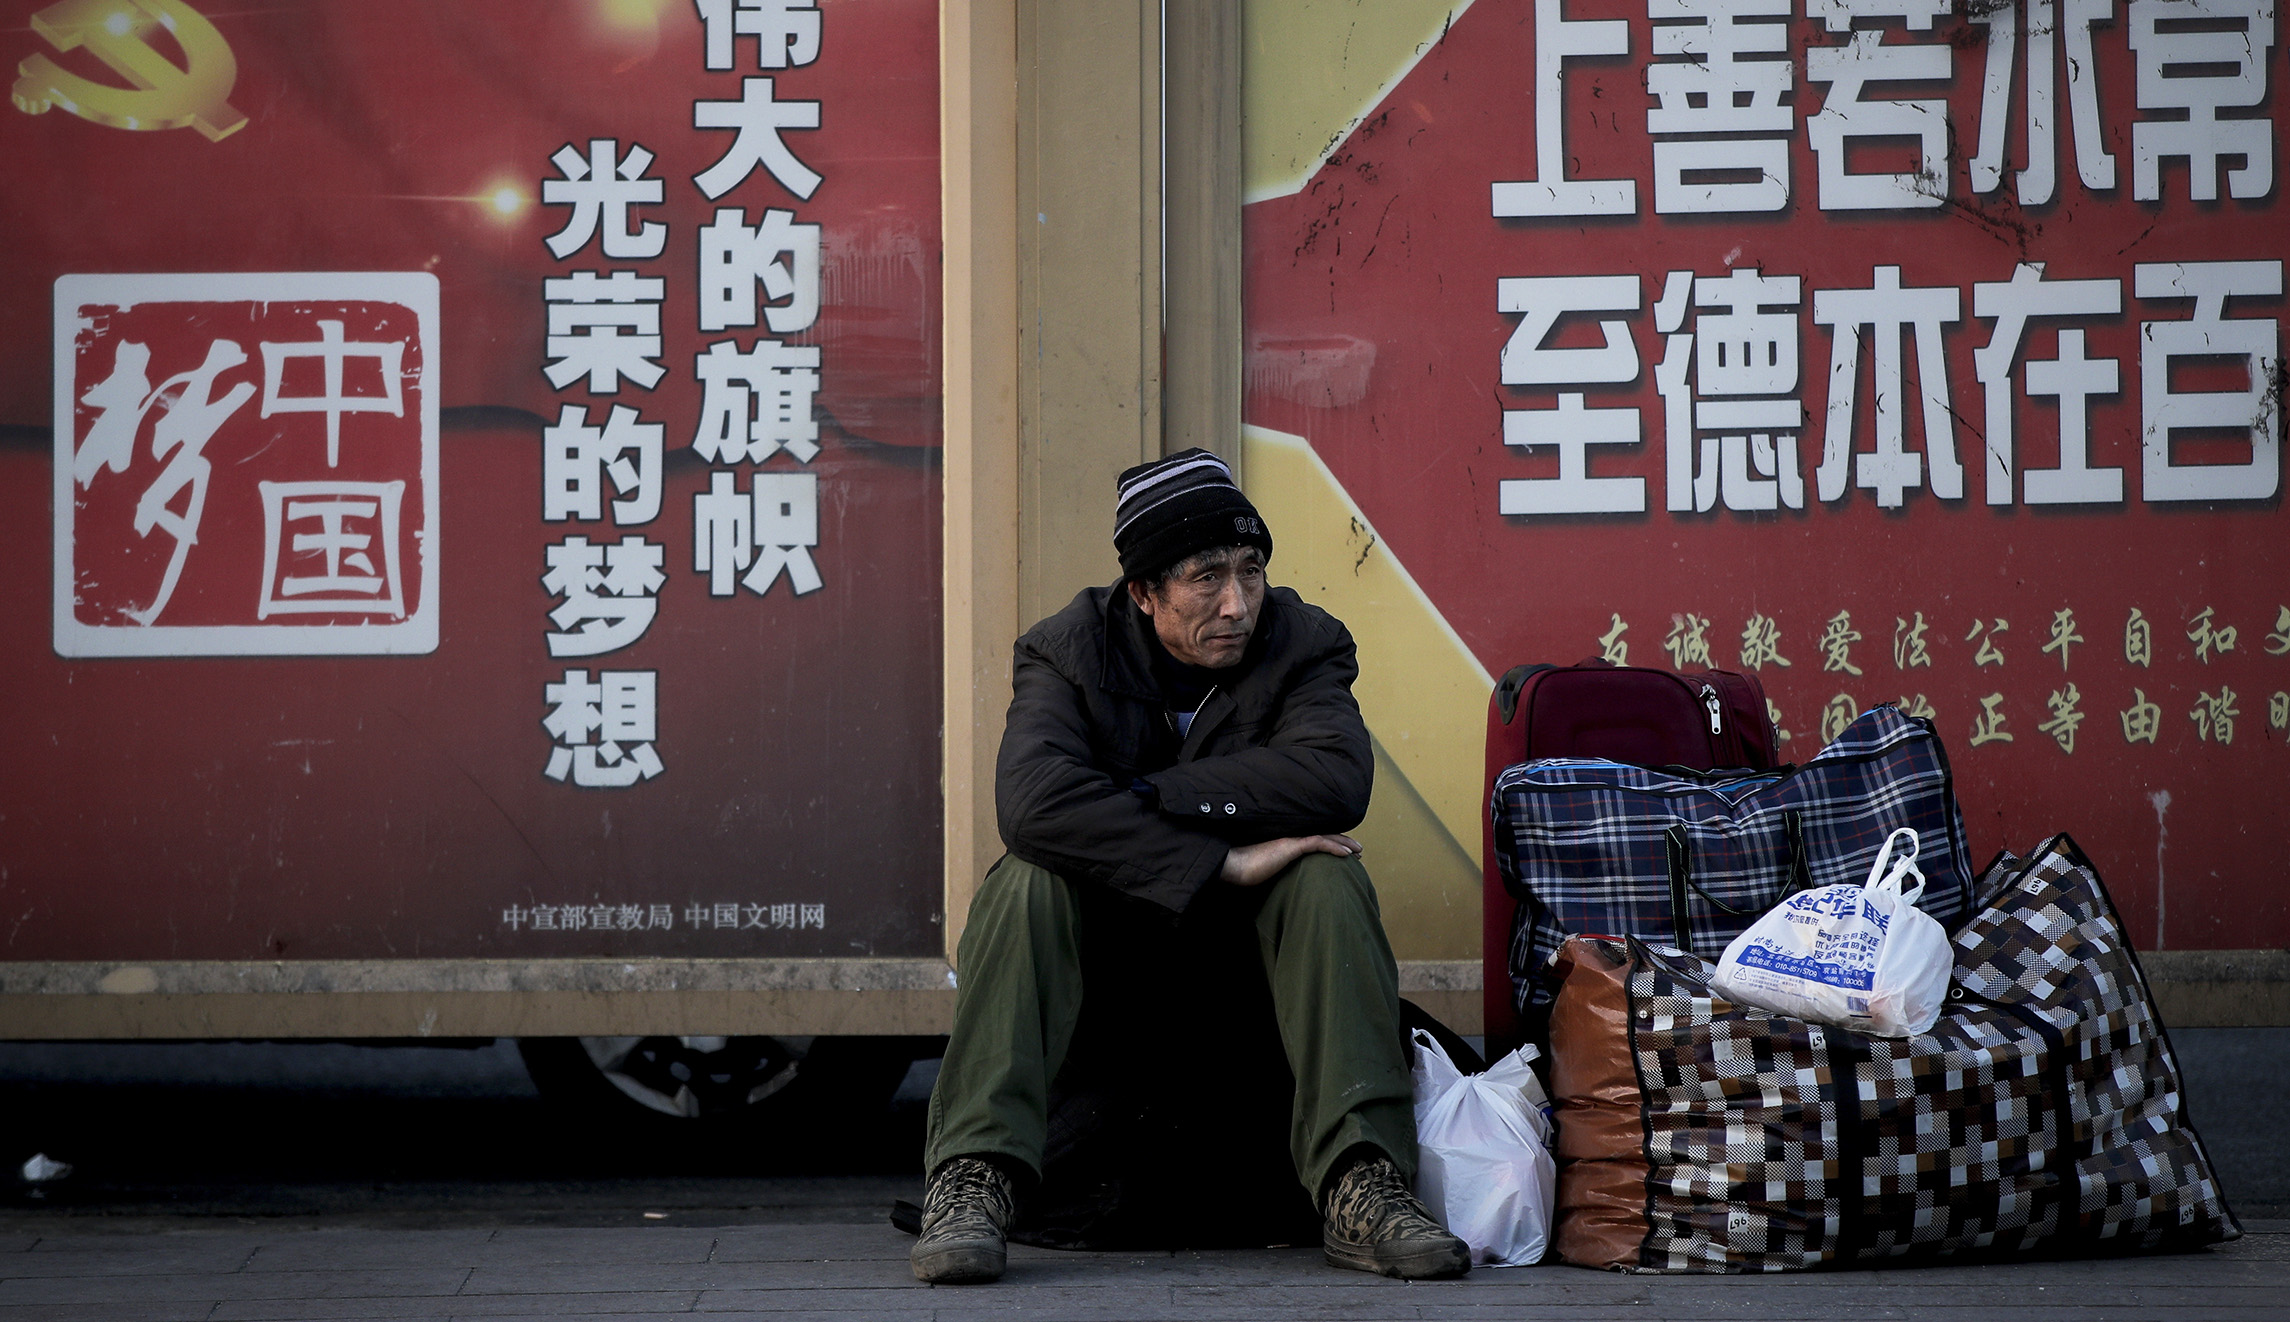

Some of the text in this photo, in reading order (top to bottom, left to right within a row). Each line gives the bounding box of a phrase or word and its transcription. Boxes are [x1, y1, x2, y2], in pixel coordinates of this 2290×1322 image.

[1491, 0, 2275, 217] 上善若水常
[693, 0, 823, 598] 伟大的旗帜
[1496, 262, 2284, 516] 至德本在百
[74, 338, 257, 627] 梦
[257, 320, 406, 621] 中国
[541, 138, 667, 788] 光荣的梦想
[502, 902, 826, 931] 中宣部宣教局 中国文明网
